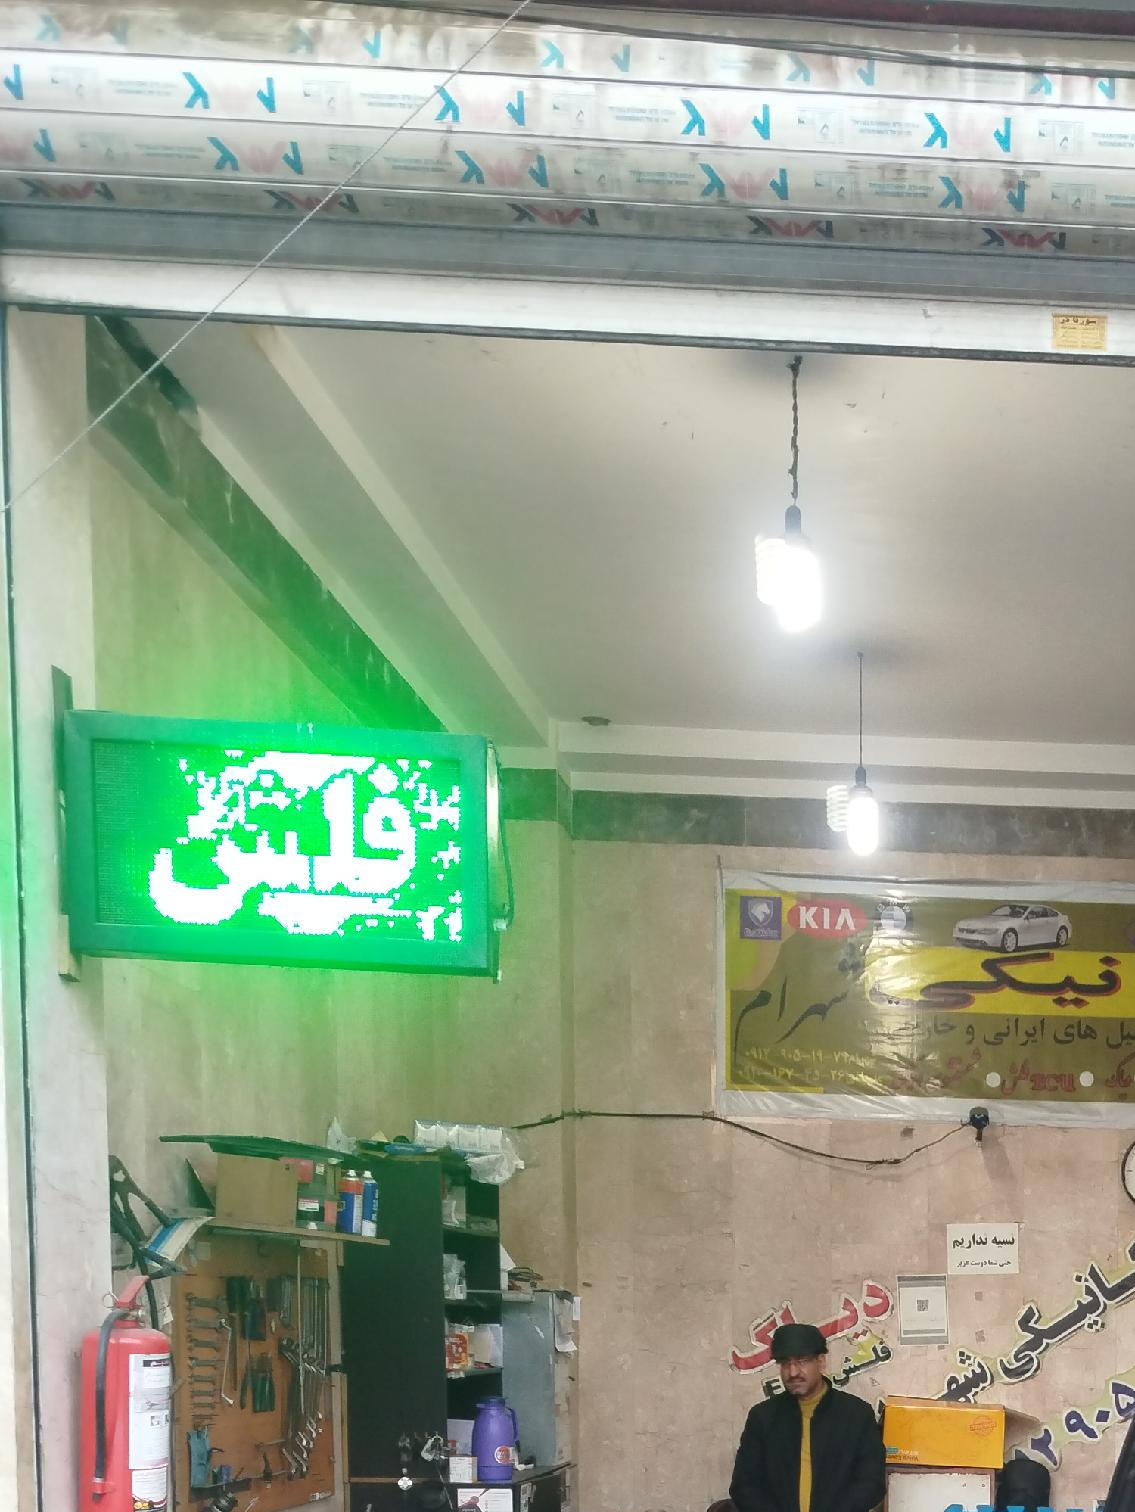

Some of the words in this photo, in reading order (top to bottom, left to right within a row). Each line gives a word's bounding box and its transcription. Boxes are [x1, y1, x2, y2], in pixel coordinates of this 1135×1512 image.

[799, 906, 856, 930] KIA
[966, 1025, 975, 1045] و
[984, 1017, 1046, 1046] ایرانی
[1053, 1019, 1097, 1043] های
[952, 1233, 988, 1249] نداریم
[991, 1233, 1015, 1248] نسیه
